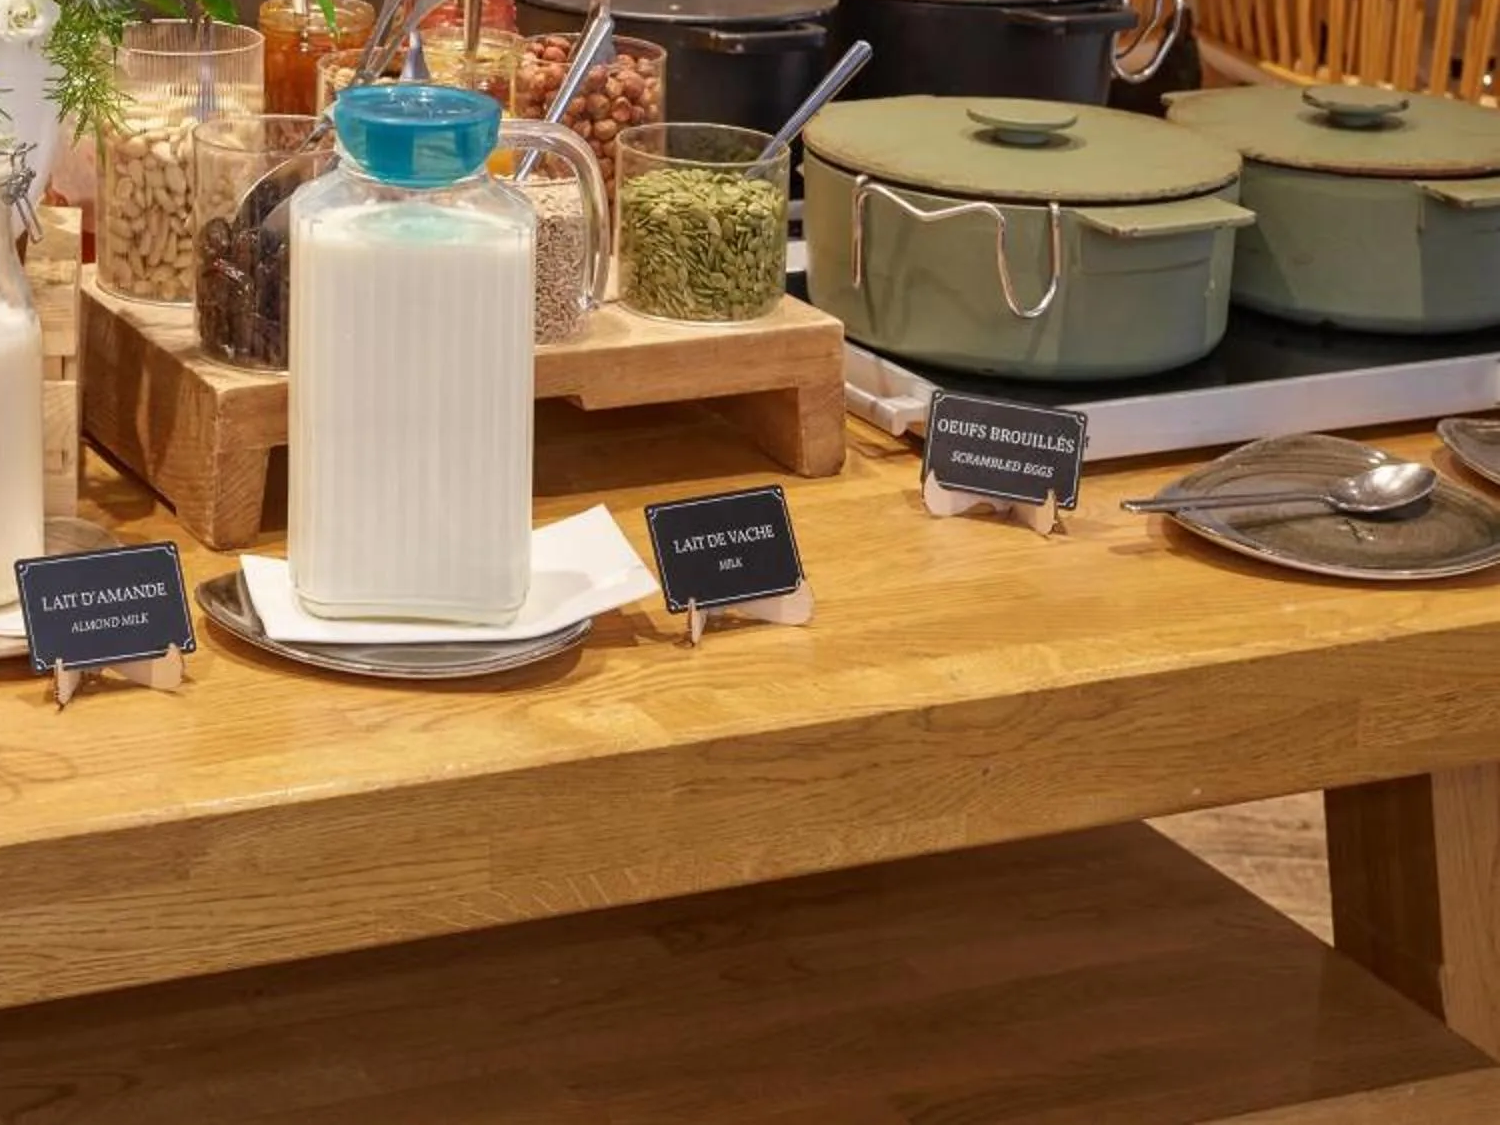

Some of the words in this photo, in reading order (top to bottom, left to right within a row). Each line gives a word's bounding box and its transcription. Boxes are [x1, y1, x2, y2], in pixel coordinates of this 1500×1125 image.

[937, 418, 987, 440] OEUFS
[989, 426, 1075, 454] BROUILLÉS
[950, 450, 1021, 472] SCRAMBLED
[1023, 462, 1054, 479] EGGS
[673, 536, 705, 554] LAIT
[707, 534, 727, 548] DE
[727, 525, 775, 544] VACHE
[719, 557, 743, 571] MILK
[41, 592, 78, 612] LAIT
[81, 582, 167, 606] D'AMANDE
[71, 616, 121, 633] ALMOND
[121, 612, 149, 628] MILK
